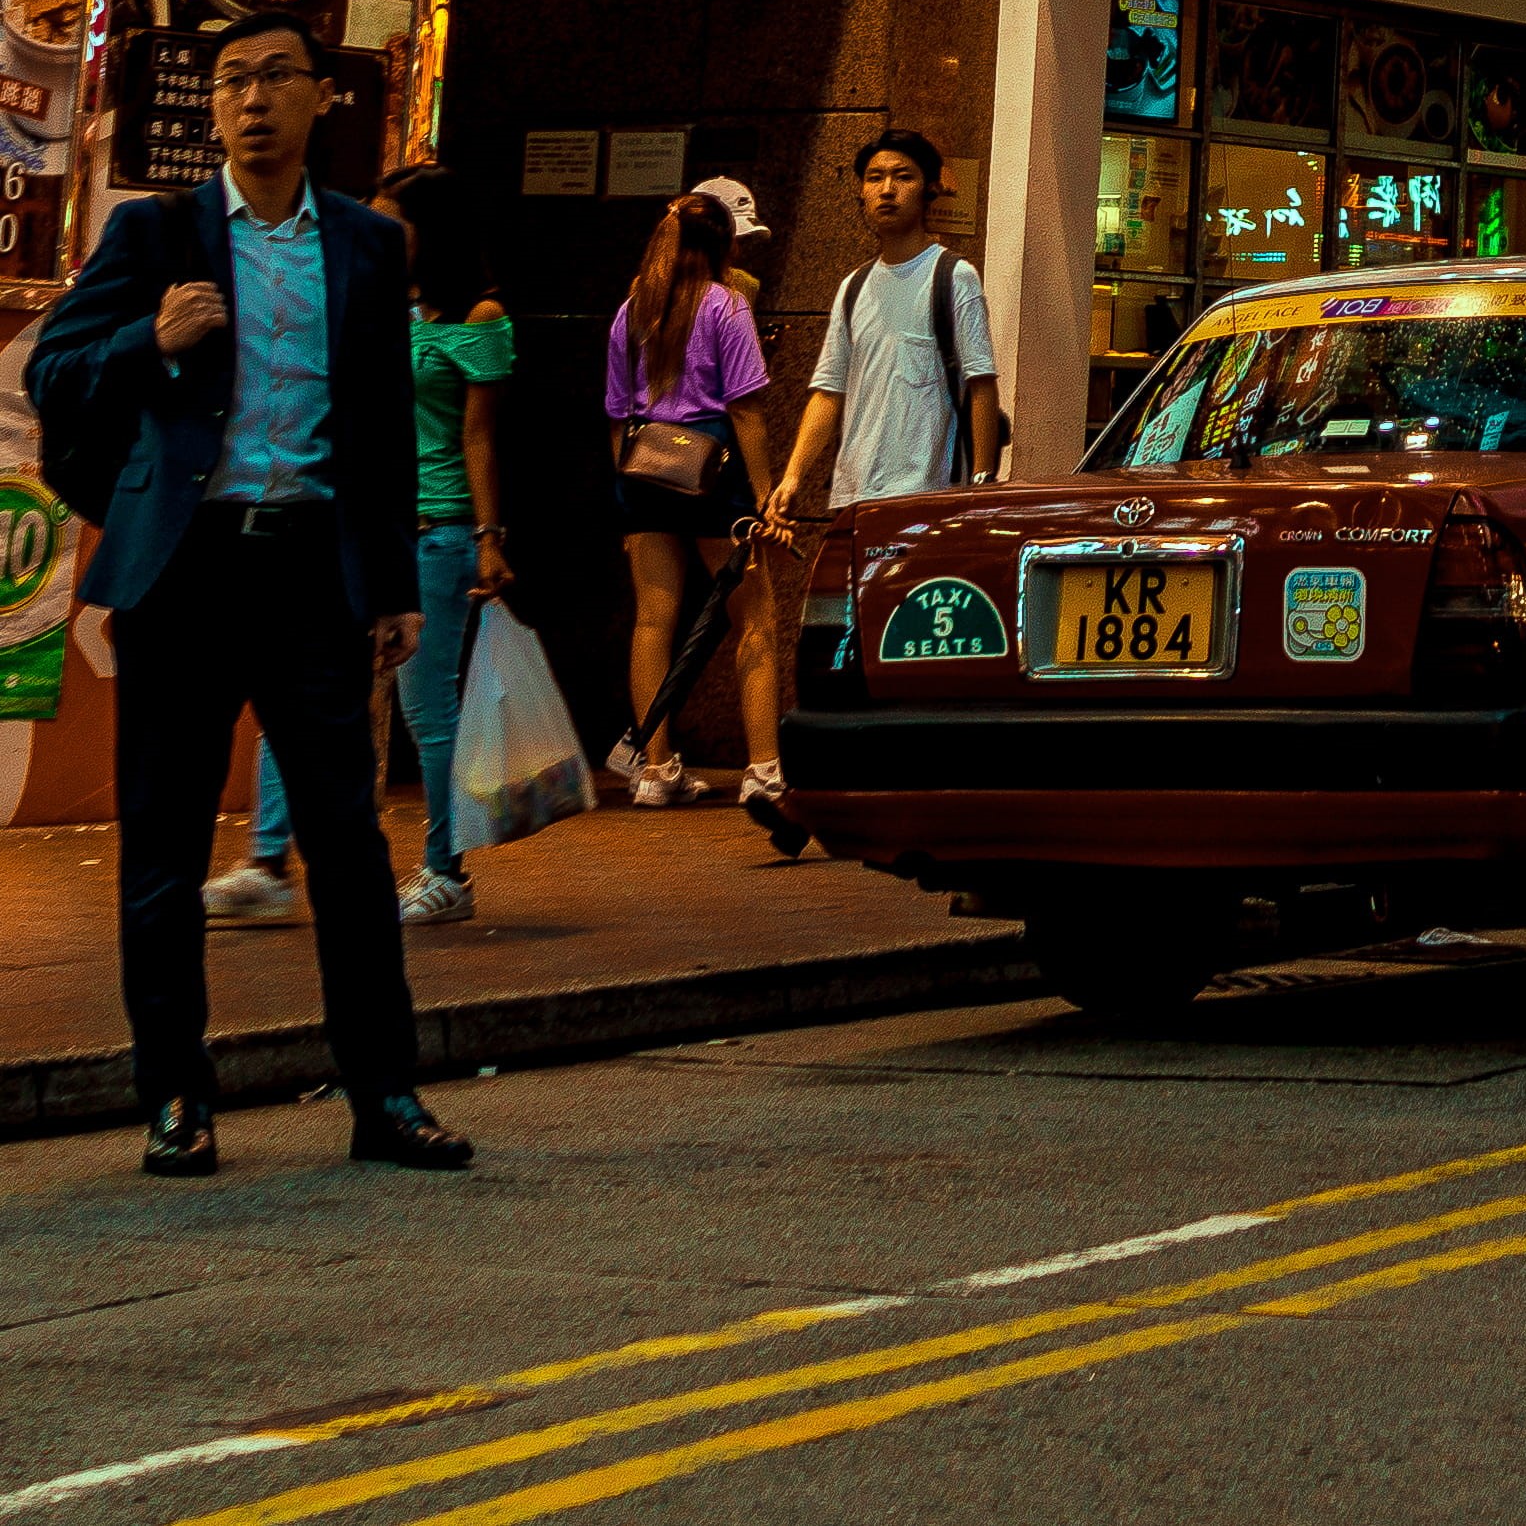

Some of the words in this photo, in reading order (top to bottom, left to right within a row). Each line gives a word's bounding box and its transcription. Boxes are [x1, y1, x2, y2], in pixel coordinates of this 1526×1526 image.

[1258, 304, 1303, 321] FACE
[1278, 529, 1323, 543] CROWN
[1333, 525, 1434, 546] COMFORT
[916, 584, 973, 613] TAXI
[1103, 565, 1167, 617] KR
[931, 604, 955, 638] 5
[902, 636, 985, 658] SEATS
[1076, 613, 1193, 662] 1884
